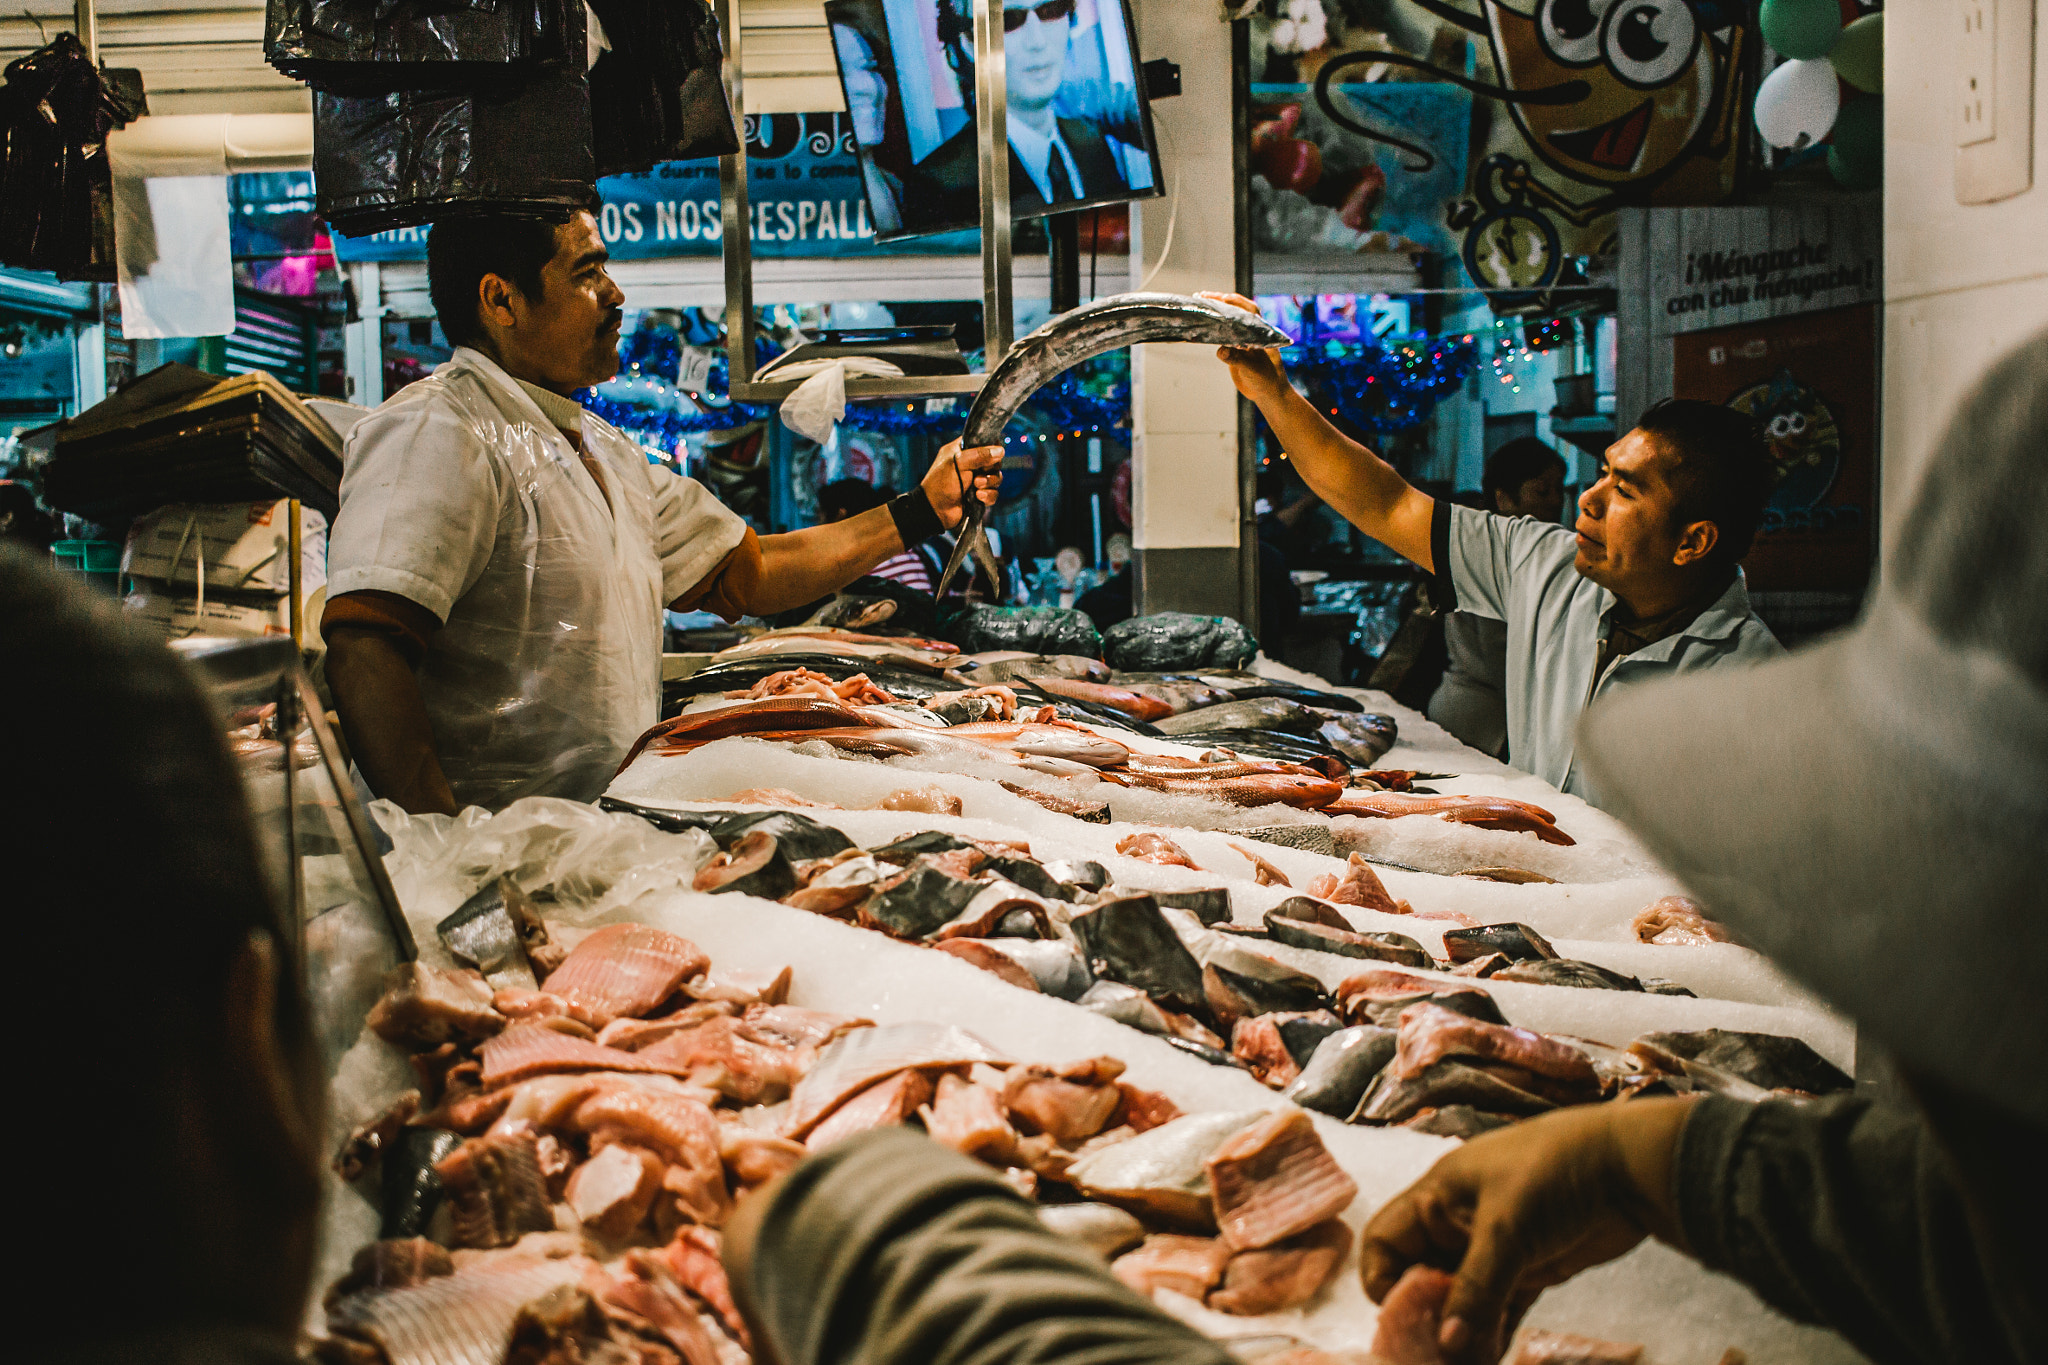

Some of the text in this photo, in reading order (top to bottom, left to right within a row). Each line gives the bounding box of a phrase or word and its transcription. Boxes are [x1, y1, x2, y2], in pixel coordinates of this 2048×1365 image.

[600, 202, 644, 242] OS
[656, 200, 723, 241] NOS
[1667, 292, 1705, 316] con
